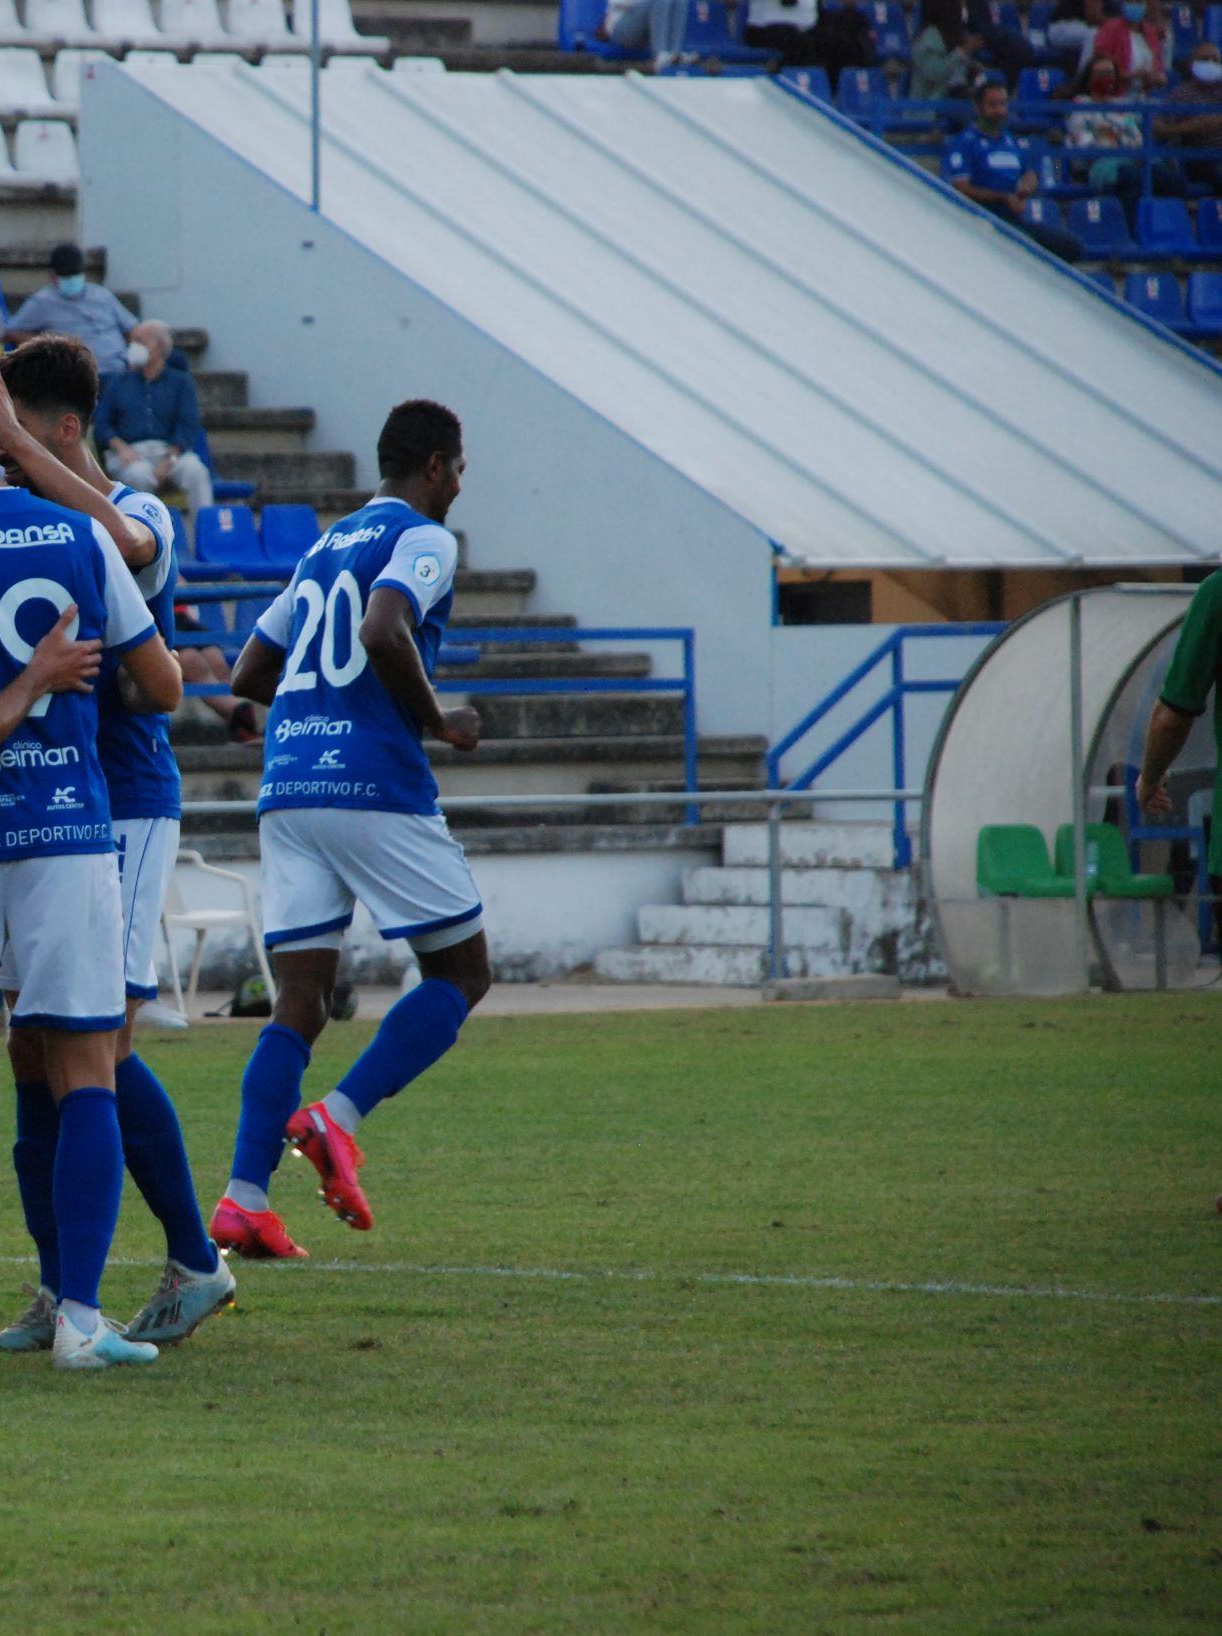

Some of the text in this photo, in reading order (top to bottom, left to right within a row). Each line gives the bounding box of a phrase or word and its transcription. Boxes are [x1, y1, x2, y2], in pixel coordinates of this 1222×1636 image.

[276, 570, 368, 696] 20
[276, 781, 351, 796] DEPORTIVO
[6, 824, 92, 847] DEPORTIVO
